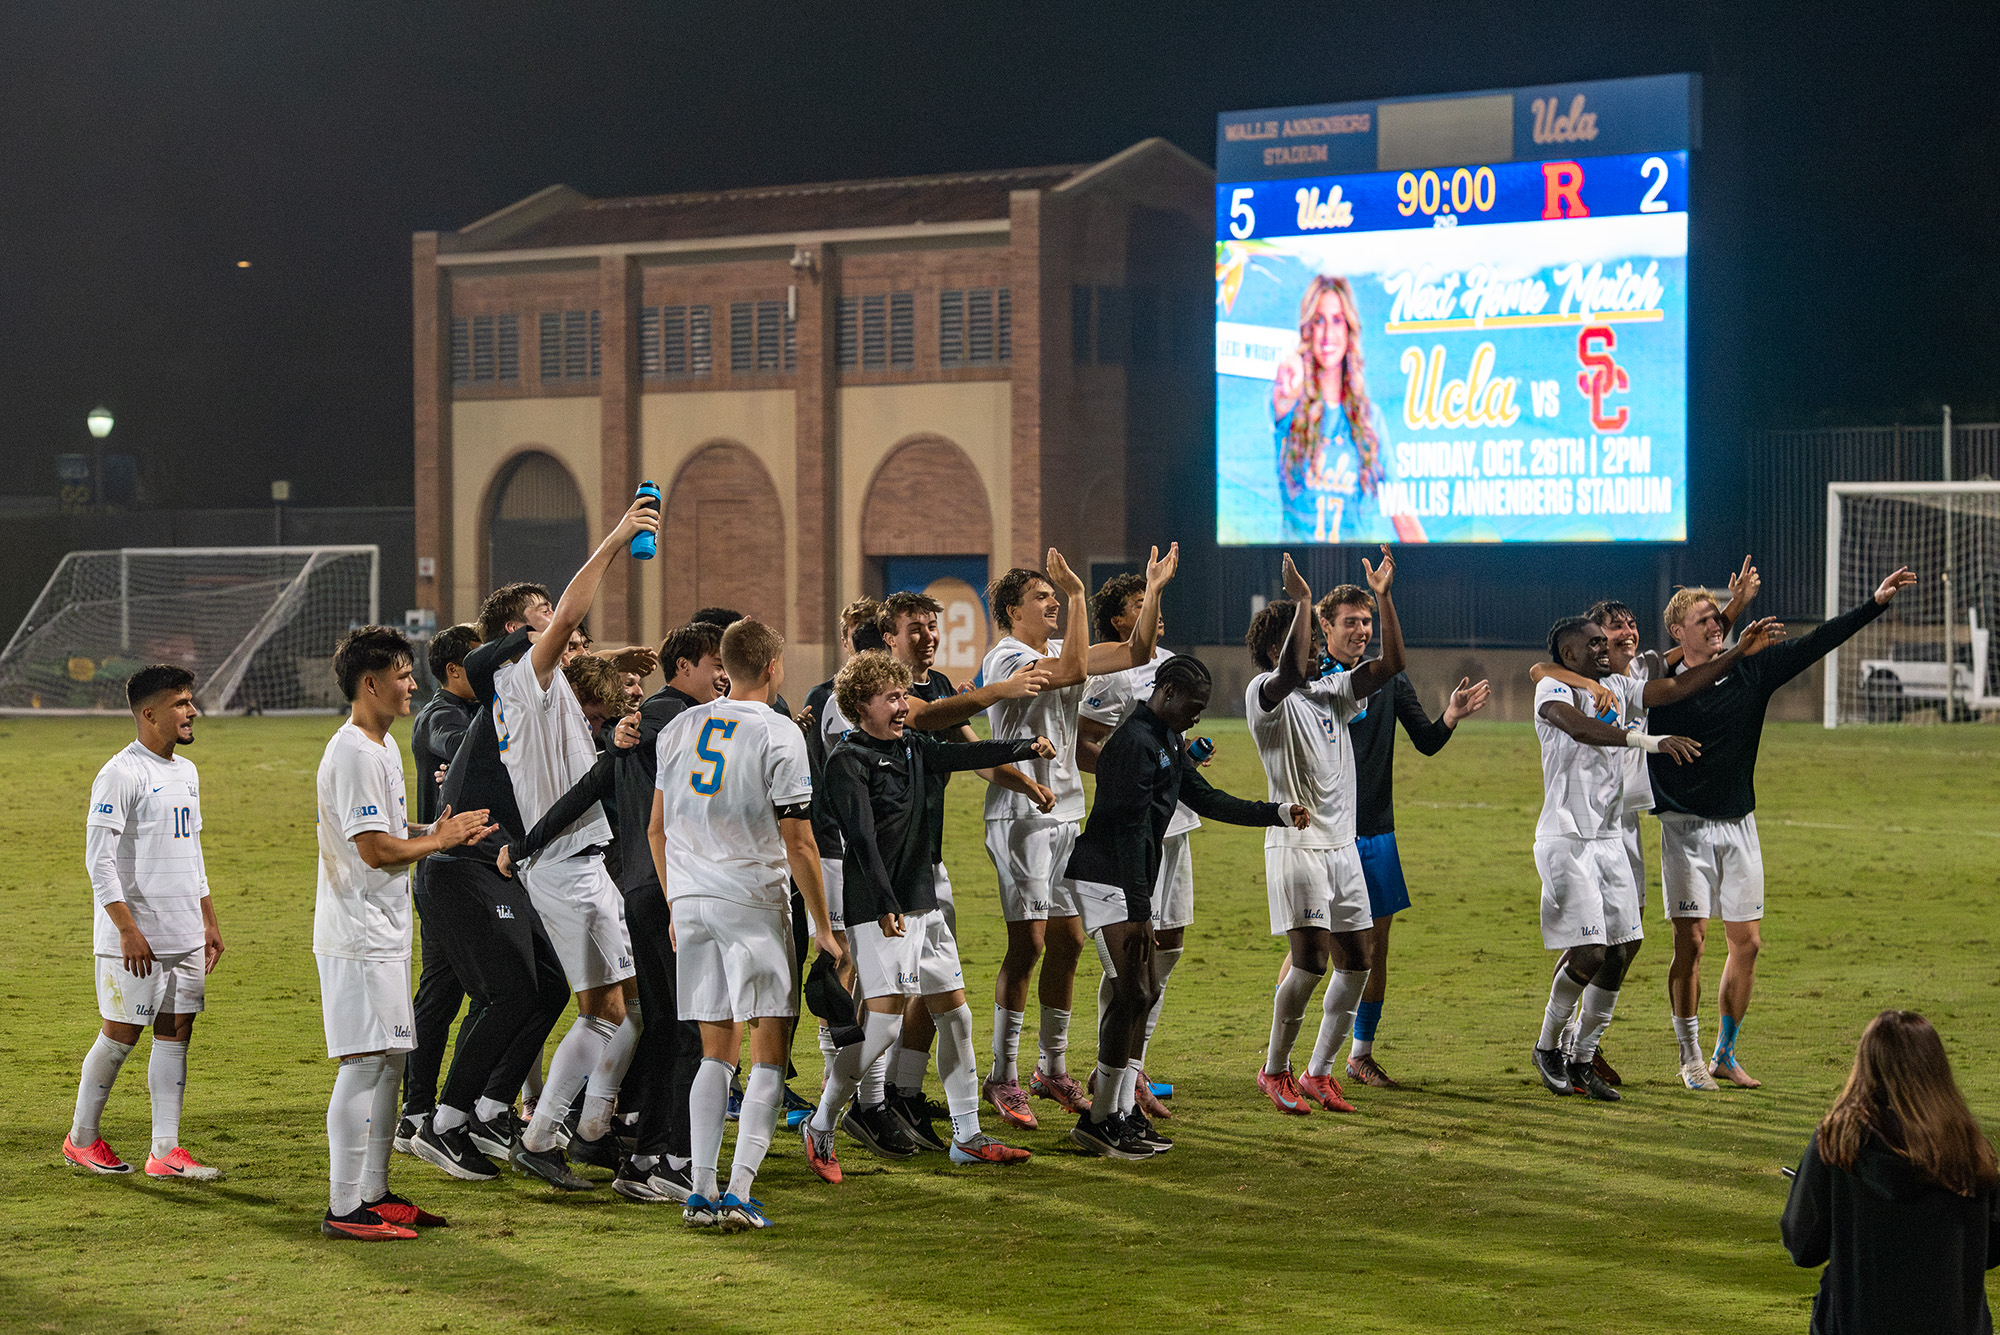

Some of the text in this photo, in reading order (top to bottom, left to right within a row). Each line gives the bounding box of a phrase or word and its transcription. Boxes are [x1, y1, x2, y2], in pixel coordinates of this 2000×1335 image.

[1225, 113, 1370, 142] WALLIS ANNENBERG
[1531, 94, 1599, 144] Ucla
[1263, 144, 1328, 166] STADIUM
[1295, 185, 1354, 230] Ucla
[1397, 166, 1496, 217] 90:00
[1541, 161, 1590, 220] R
[1639, 156, 1669, 214] 2
[1229, 187, 1256, 240] 5
[1384, 260, 1665, 330] Next Home Match
[1400, 341, 1520, 430] Ucla
[1395, 440, 1479, 480] SUNDAY,
[1482, 438, 1528, 478] OCT.
[1529, 436, 1586, 477] 26TH
[1601, 435, 1652, 475] 2PM
[1377, 476, 1672, 517] WALLIS ANNENBERG STADIUM
[1314, 496, 1343, 543] 17
[173, 806, 191, 839] 10
[1303, 908, 1324, 919] Ucla
[1678, 900, 1699, 911] Ucla
[1581, 925, 1599, 936] Ucla
[897, 971, 920, 984] Ucla
